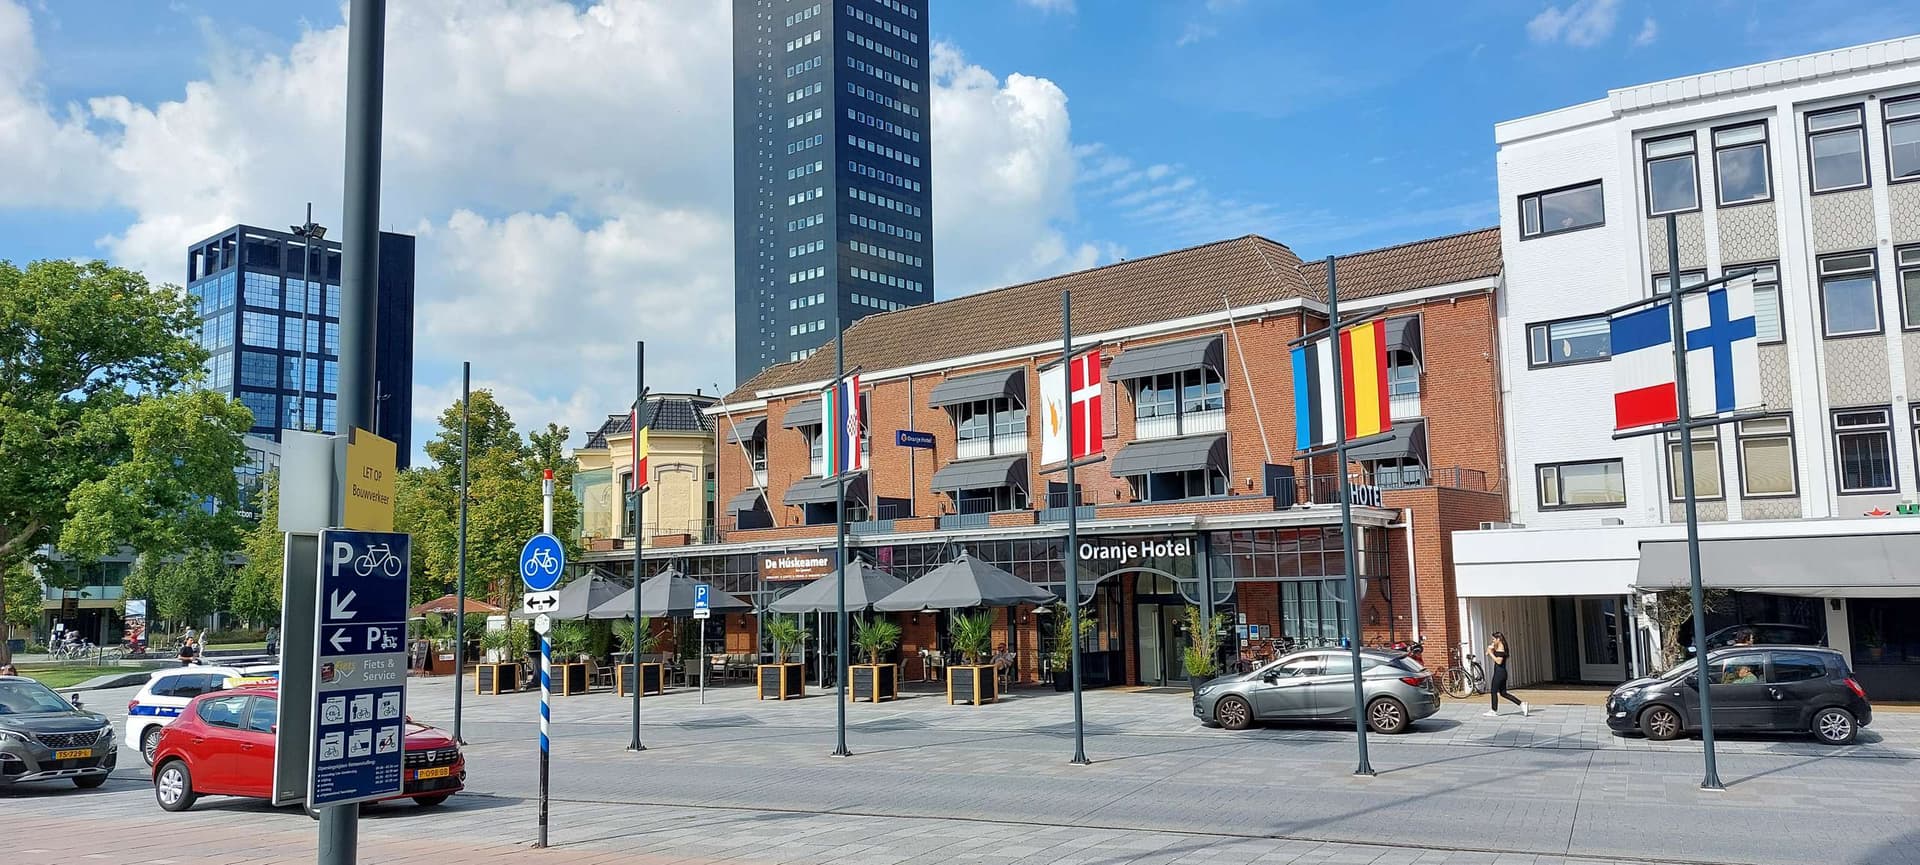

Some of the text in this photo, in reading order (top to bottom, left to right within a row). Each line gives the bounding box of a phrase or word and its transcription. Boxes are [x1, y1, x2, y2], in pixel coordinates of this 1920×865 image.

[362, 466, 383, 481] LET OP
[352, 483, 389, 504] Bouwverkeer
[1079, 537, 1191, 564] Oranje Hotel
[332, 541, 354, 577] P
[765, 556, 829, 569] De Húskeamer
[698, 587, 706, 600] P
[366, 627, 382, 651] P
[363, 658, 396, 670] Fiets &
[363, 670, 396, 682] Service
